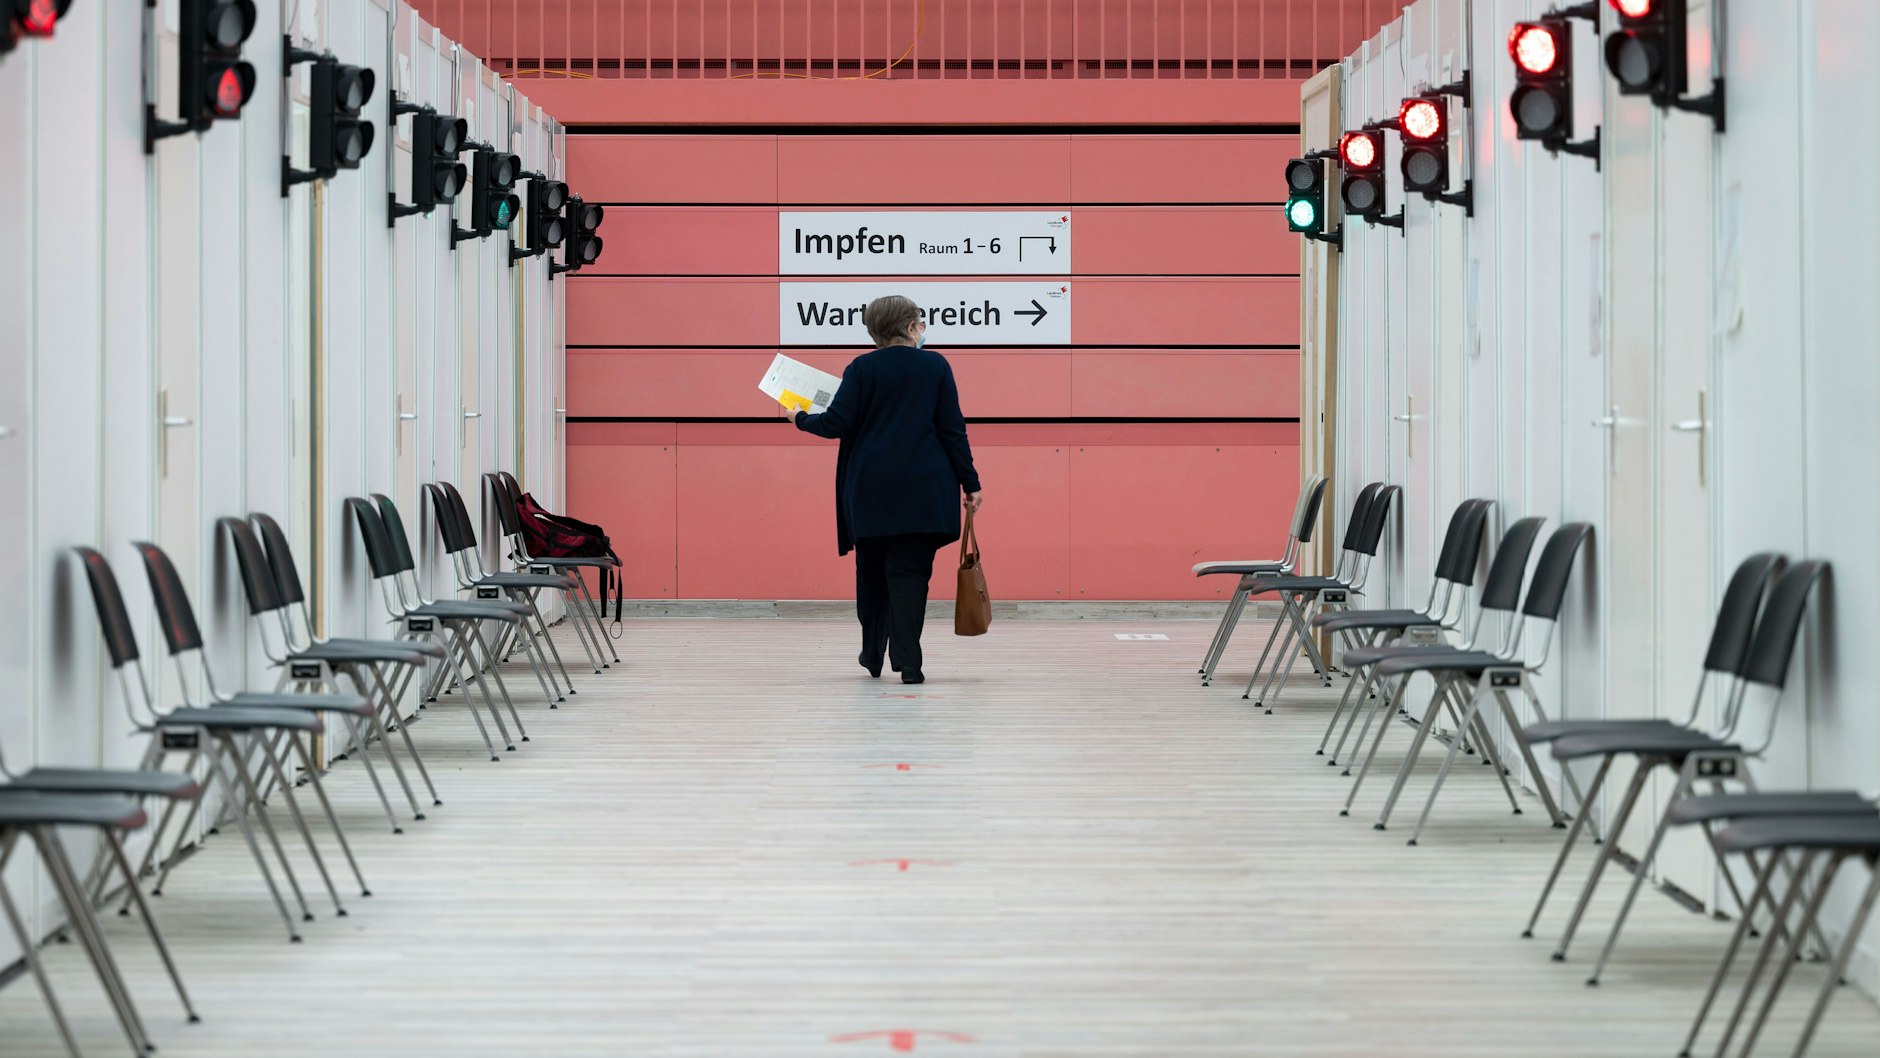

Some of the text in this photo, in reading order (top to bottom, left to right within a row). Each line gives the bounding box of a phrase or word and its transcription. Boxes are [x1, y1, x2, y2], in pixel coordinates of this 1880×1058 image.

[794, 226, 906, 261] Impfen
[918, 242, 959, 255] Raum
[796, 299, 1002, 327] Wartreich
